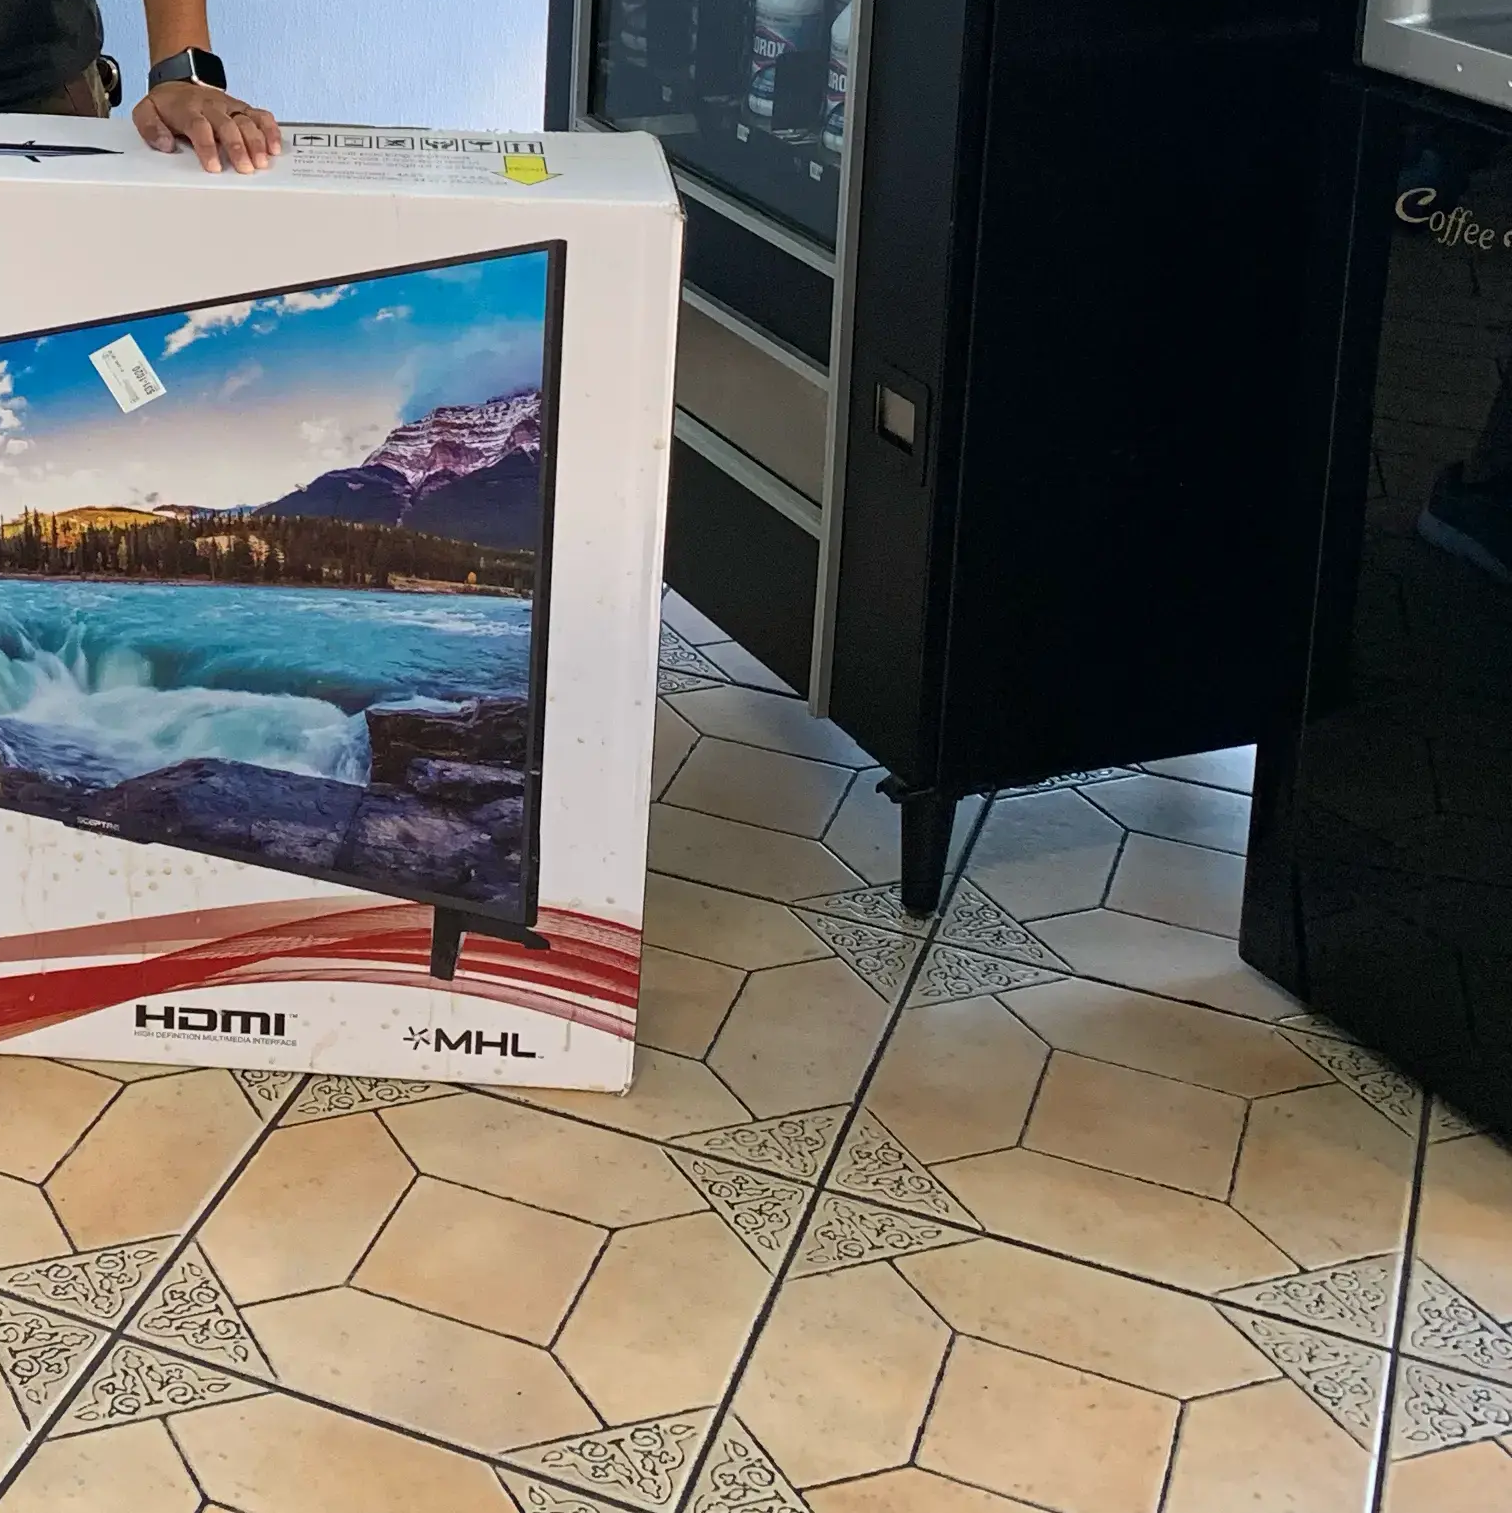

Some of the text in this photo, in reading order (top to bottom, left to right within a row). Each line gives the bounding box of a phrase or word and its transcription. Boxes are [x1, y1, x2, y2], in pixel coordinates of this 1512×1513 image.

[1395, 187, 1495, 250] Coffee
[133, 1030, 297, 1046] HIGH DEFINITION MULTIMEDIA INTERFACE
[434, 1028, 536, 1058] MHL
